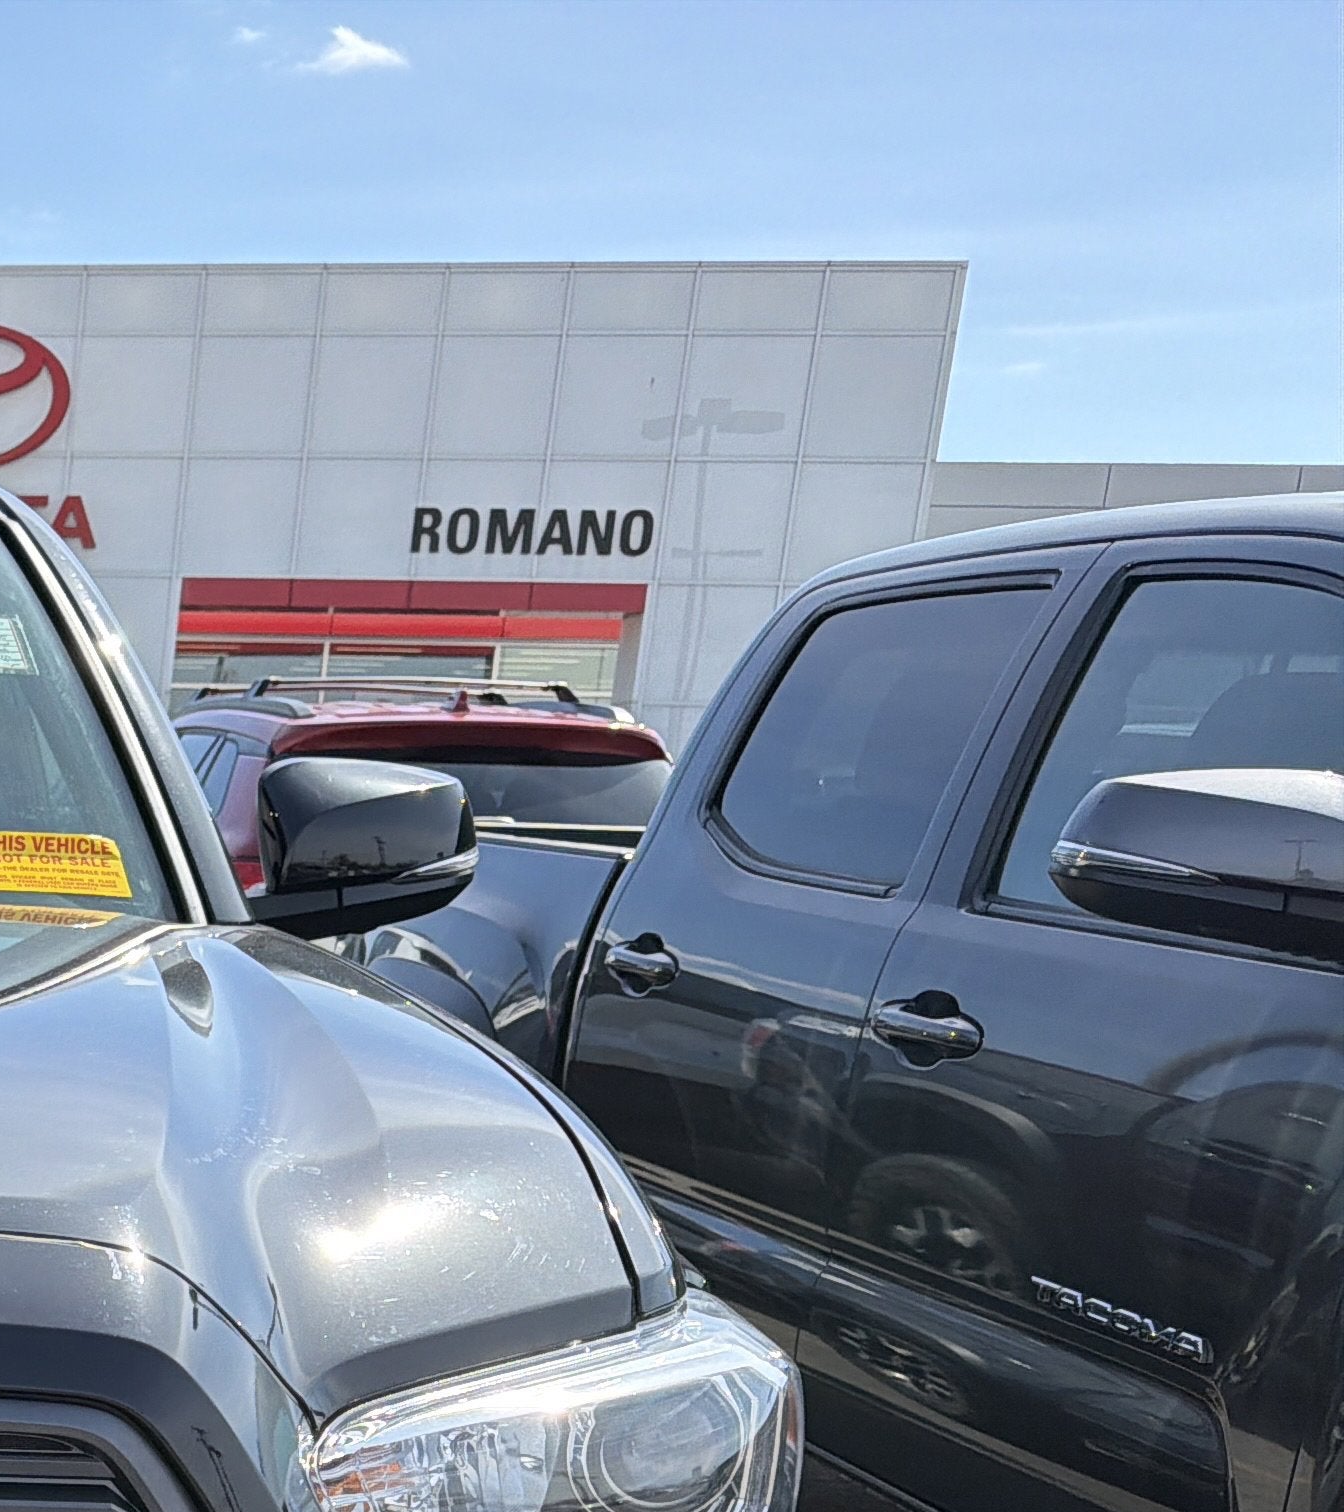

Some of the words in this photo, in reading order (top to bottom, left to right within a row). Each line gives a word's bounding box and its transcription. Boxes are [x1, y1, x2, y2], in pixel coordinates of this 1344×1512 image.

[410, 507, 654, 557] ROMANO
[29, 854, 63, 866] FOR
[69, 856, 112, 869] SALE
[31, 836, 113, 855] VEHICLE
[1030, 1275, 1214, 1364] TACOMA
